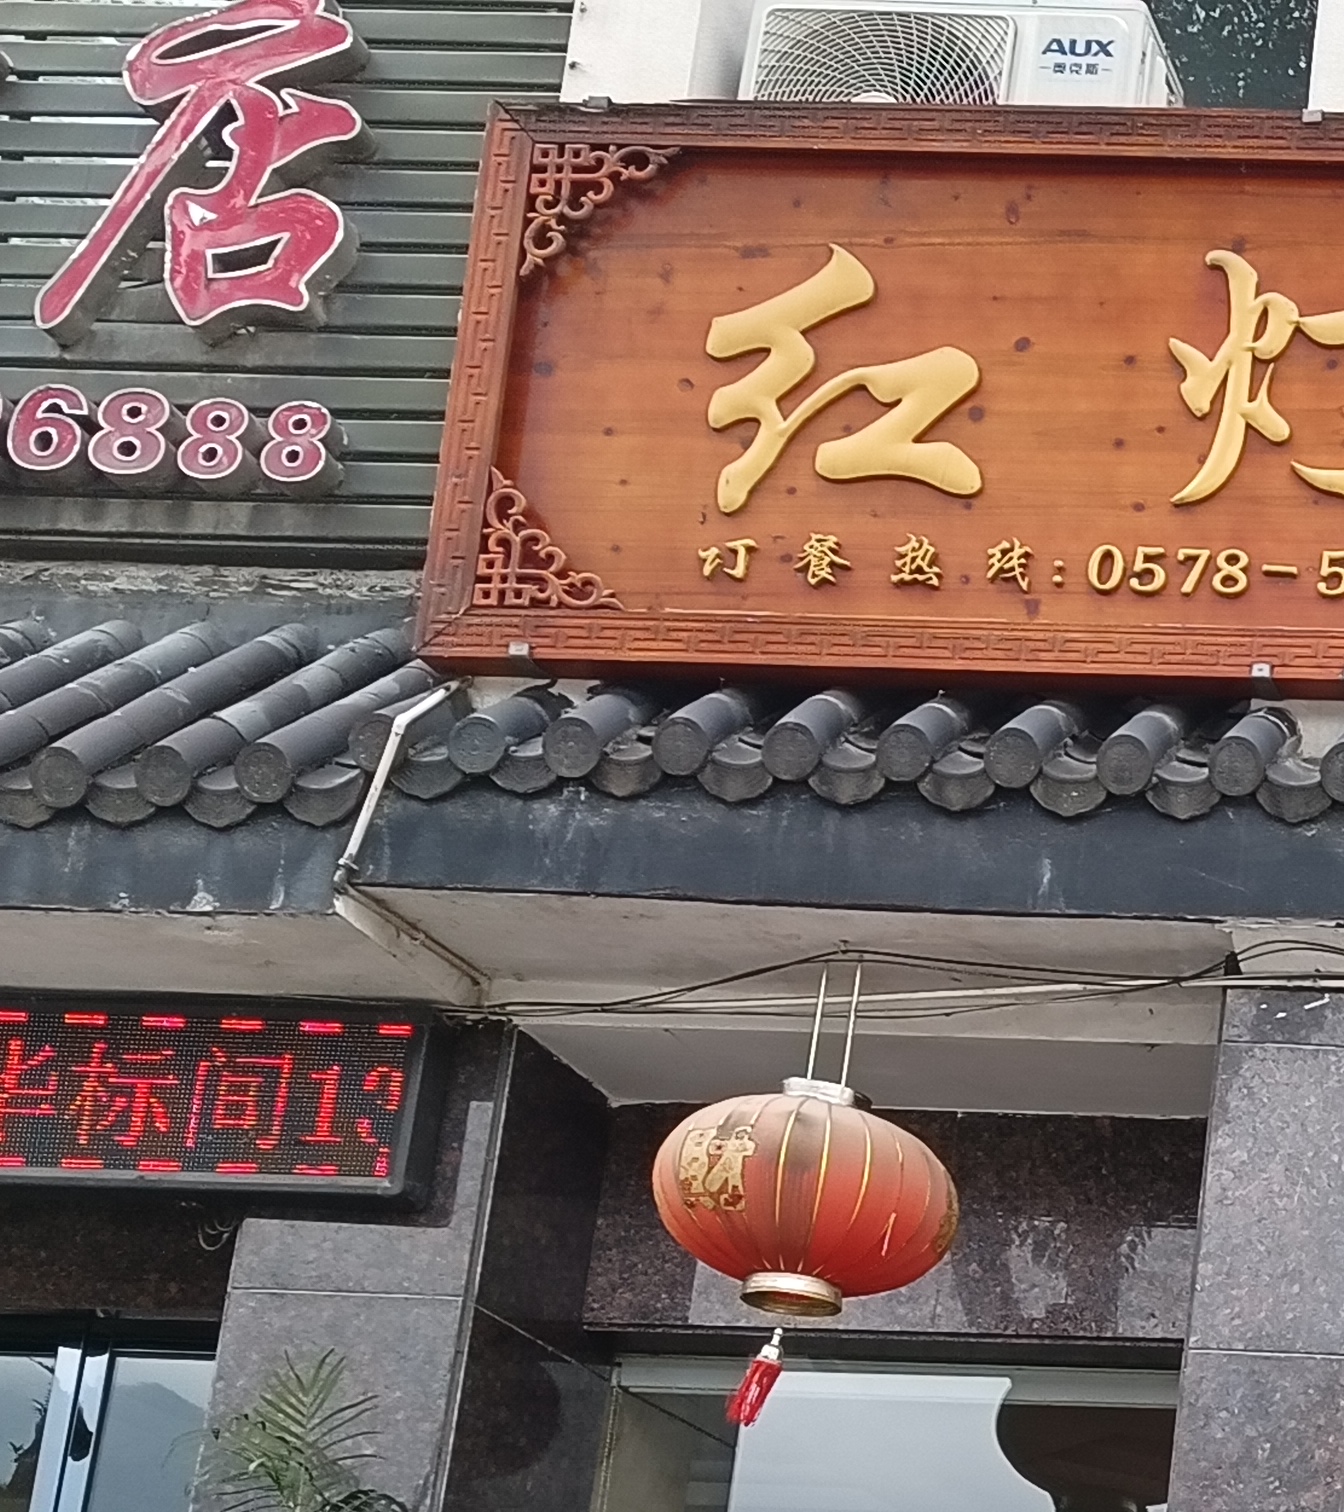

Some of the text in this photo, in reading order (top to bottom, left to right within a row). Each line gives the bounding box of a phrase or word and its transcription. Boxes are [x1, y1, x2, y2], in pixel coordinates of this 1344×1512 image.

[1041, 38, 1116, 58] AUX
[1052, 61, 1100, 76] 奥克斯
[35, 0, 362, 328] 店
[7, 384, 331, 482] 6888
